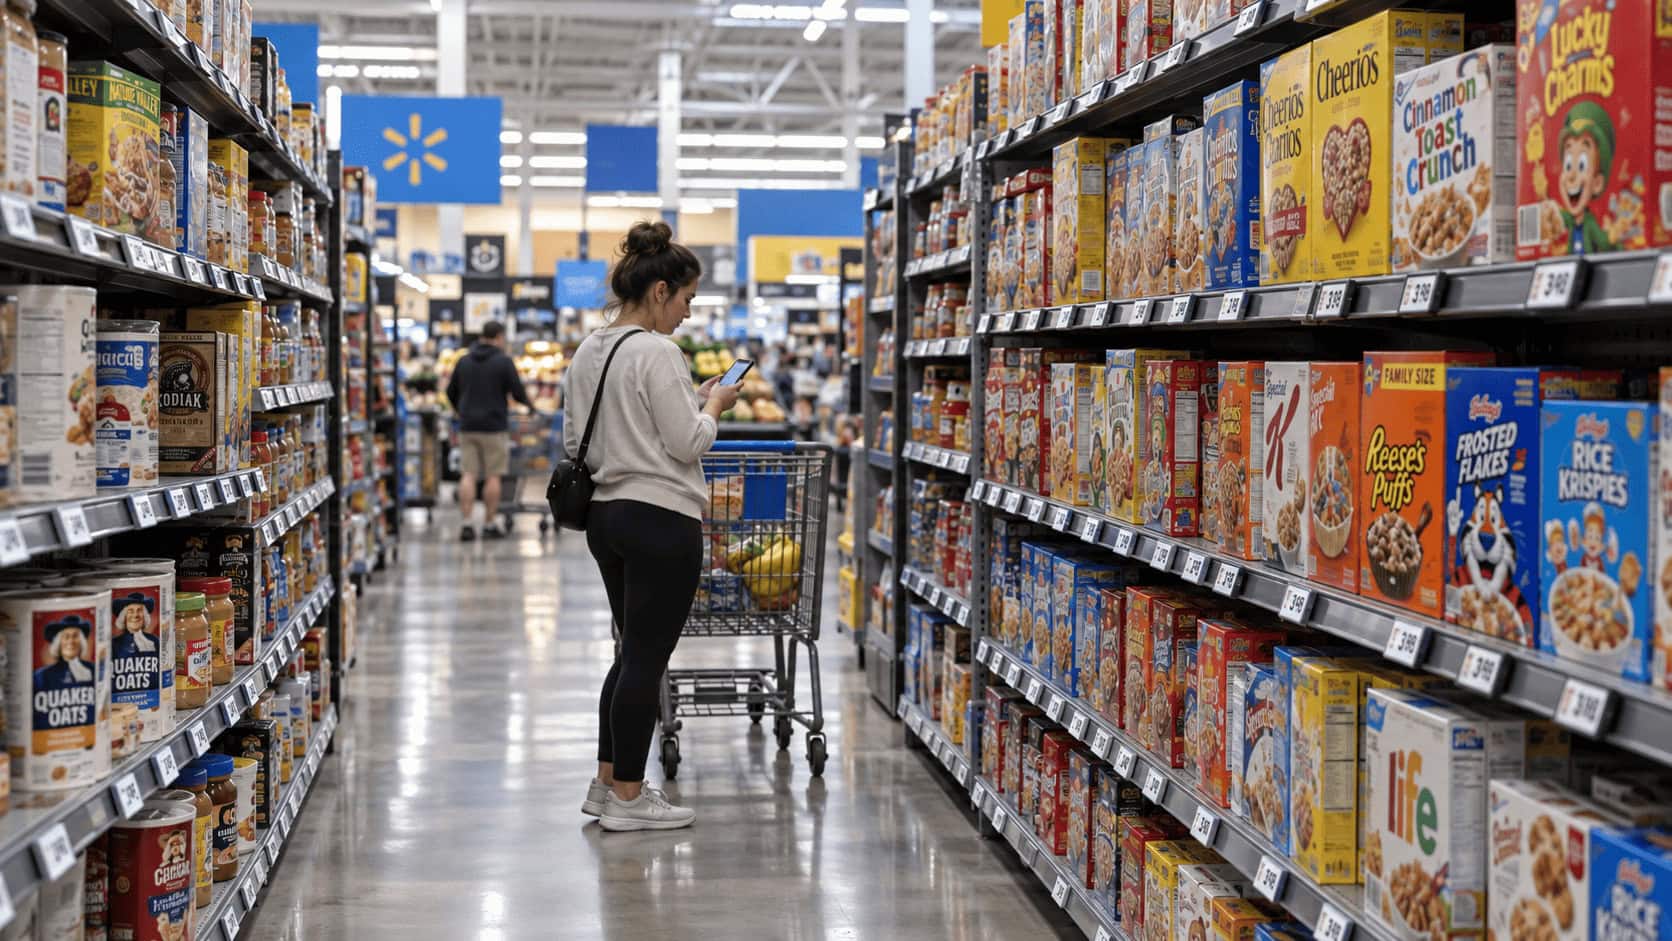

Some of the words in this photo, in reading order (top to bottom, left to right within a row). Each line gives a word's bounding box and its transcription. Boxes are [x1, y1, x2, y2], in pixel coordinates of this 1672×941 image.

[1550, 4, 1612, 69] Lucky
[1316, 49, 1379, 103] Cheerios
[1544, 54, 1615, 117] Charms
[1262, 87, 1304, 134] Cheerios
[1403, 76, 1476, 133] Cinnamon
[1415, 107, 1464, 158] Toast
[1406, 132, 1476, 195] Crunch
[1384, 368, 1412, 385] FAMILY
[1416, 368, 1436, 385] SIZE
[1265, 383, 1300, 492] K
[1366, 425, 1426, 474] Reese's
[1456, 422, 1517, 461] FROSTED
[1572, 440, 1613, 473] RICE
[1458, 450, 1510, 484] FLAKES
[1558, 468, 1628, 507] KRISPIES
[1371, 472, 1414, 511] Puffs
[34, 686, 96, 713] QUAKER
[115, 672, 150, 690] OATS
[48, 706, 88, 727] OATS
[1388, 749, 1438, 856] life
